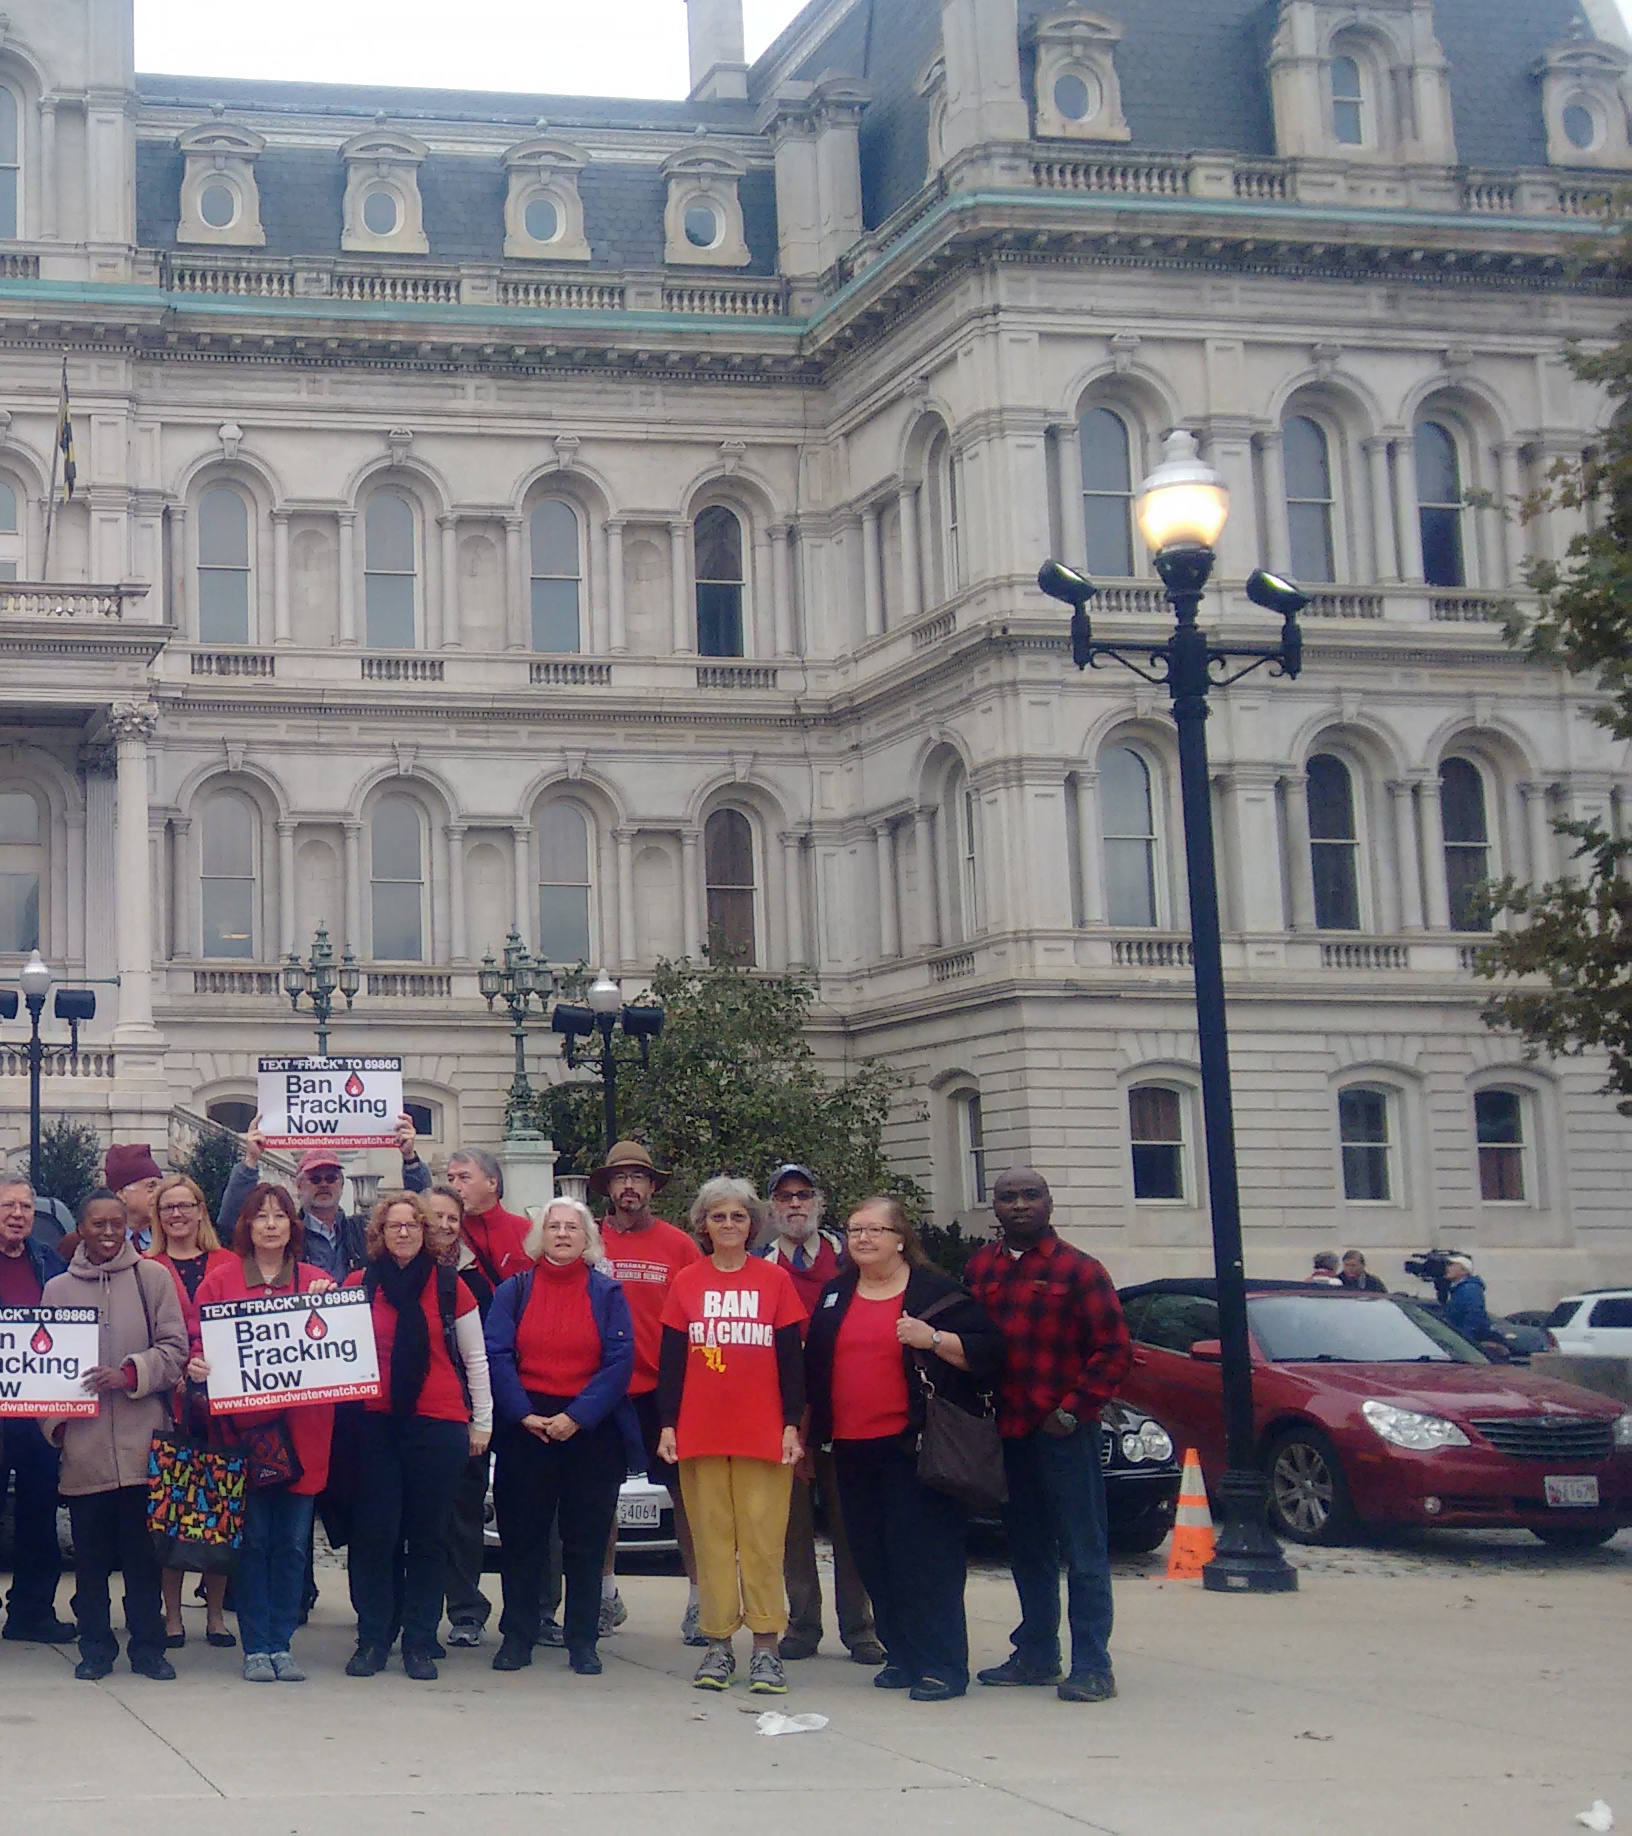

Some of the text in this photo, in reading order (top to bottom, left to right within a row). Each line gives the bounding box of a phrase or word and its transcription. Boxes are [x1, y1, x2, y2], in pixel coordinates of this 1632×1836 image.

[261, 1060, 291, 1070] TEXT
[345, 1059, 363, 1070] TO
[364, 1059, 399, 1070] 69866
[286, 1075, 332, 1094] Ban
[286, 1094, 387, 1118] Fracking
[286, 1115, 339, 1134] Now
[32, 1308, 52, 1321] TO
[54, 1309, 96, 1322] 69866
[202, 1303, 238, 1319] TEXT
[302, 1294, 323, 1307] TO
[324, 1289, 366, 1305] 69866
[703, 1290, 759, 1319] BAN
[234, 1320, 290, 1344] Ban
[236, 1338, 358, 1369] Fracking
[240, 1368, 303, 1393] Now
[213, 1384, 378, 1410] www.foodandwaterwatch.org
